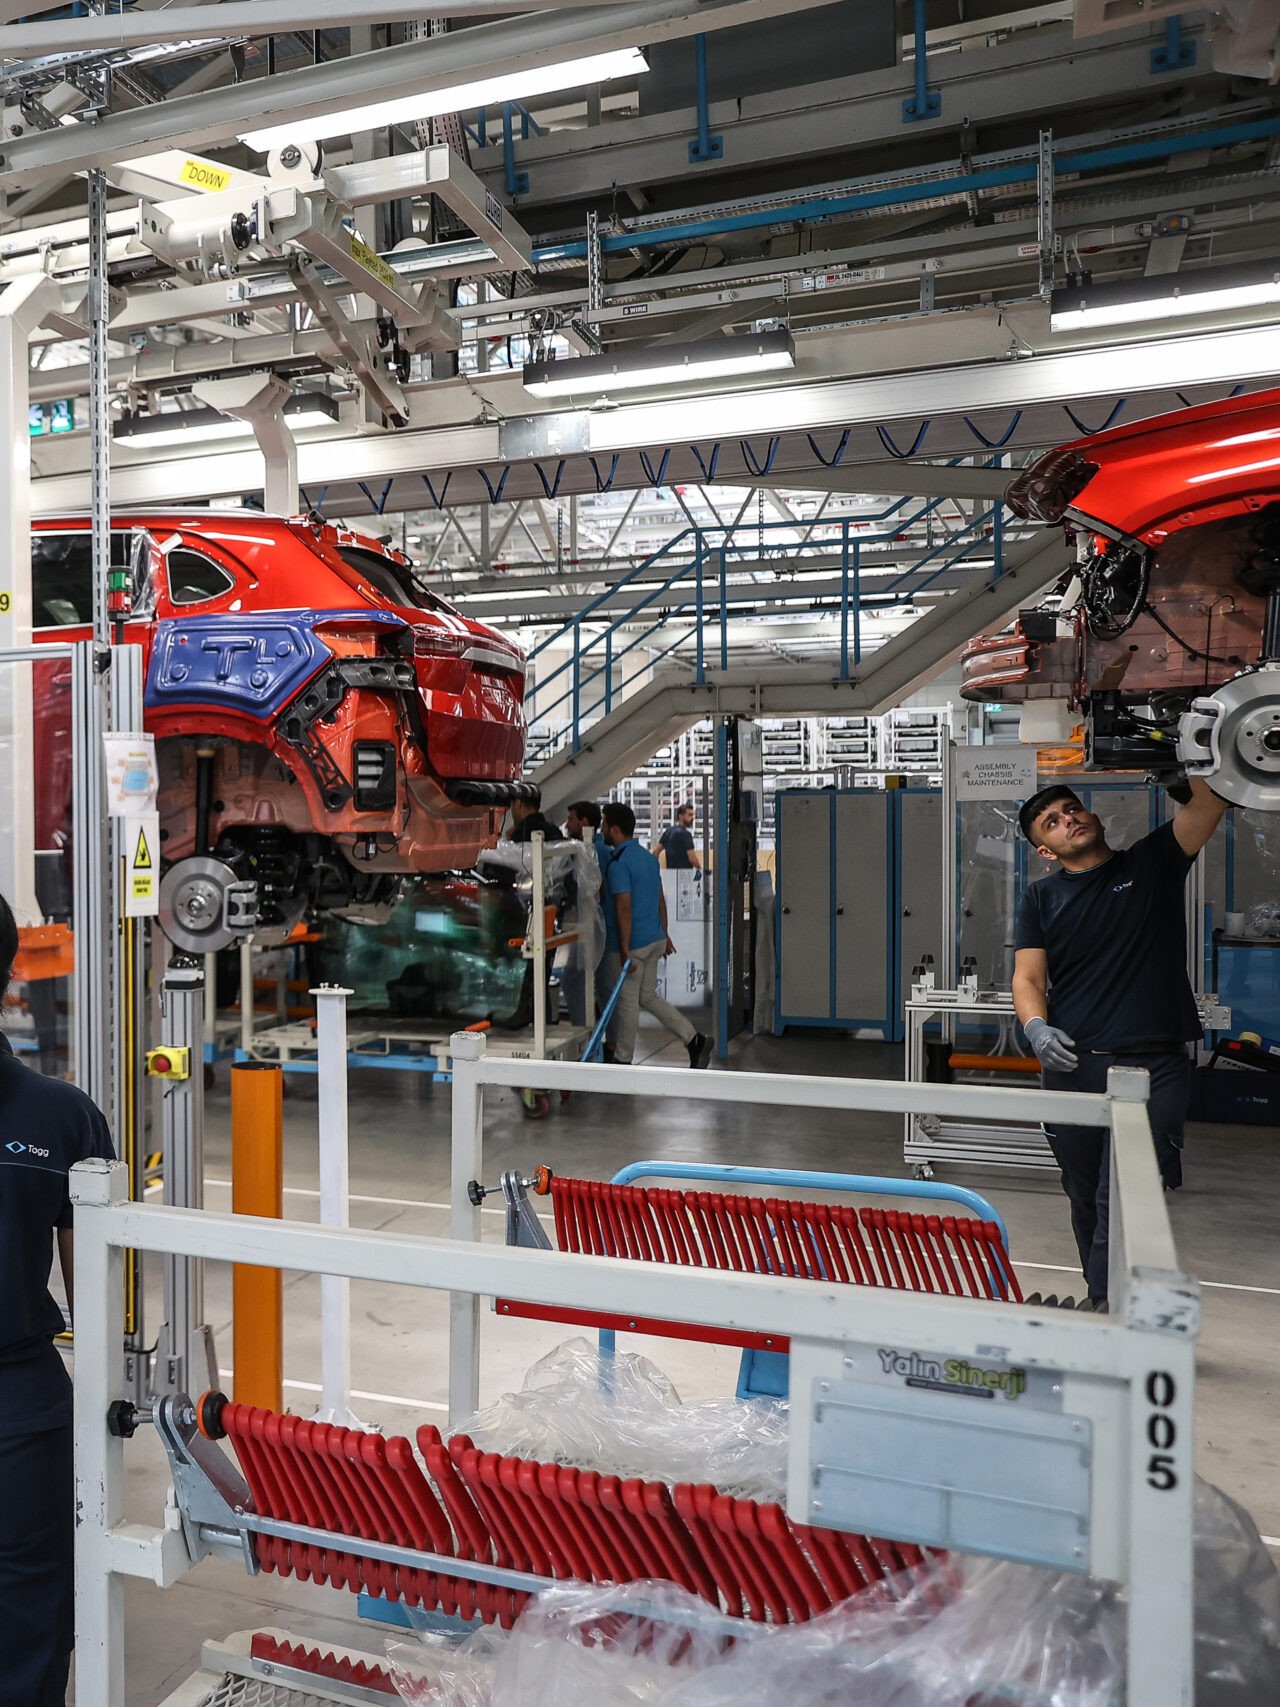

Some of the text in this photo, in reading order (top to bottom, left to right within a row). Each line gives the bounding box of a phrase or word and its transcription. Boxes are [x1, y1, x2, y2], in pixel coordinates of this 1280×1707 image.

[188, 166, 225, 188] DOWN
[630, 305, 647, 314] WIRE
[28, 1144, 49, 1157] Togg
[943, 1359, 1027, 1401] Sinerji
[1145, 1370, 1177, 1491] 005
